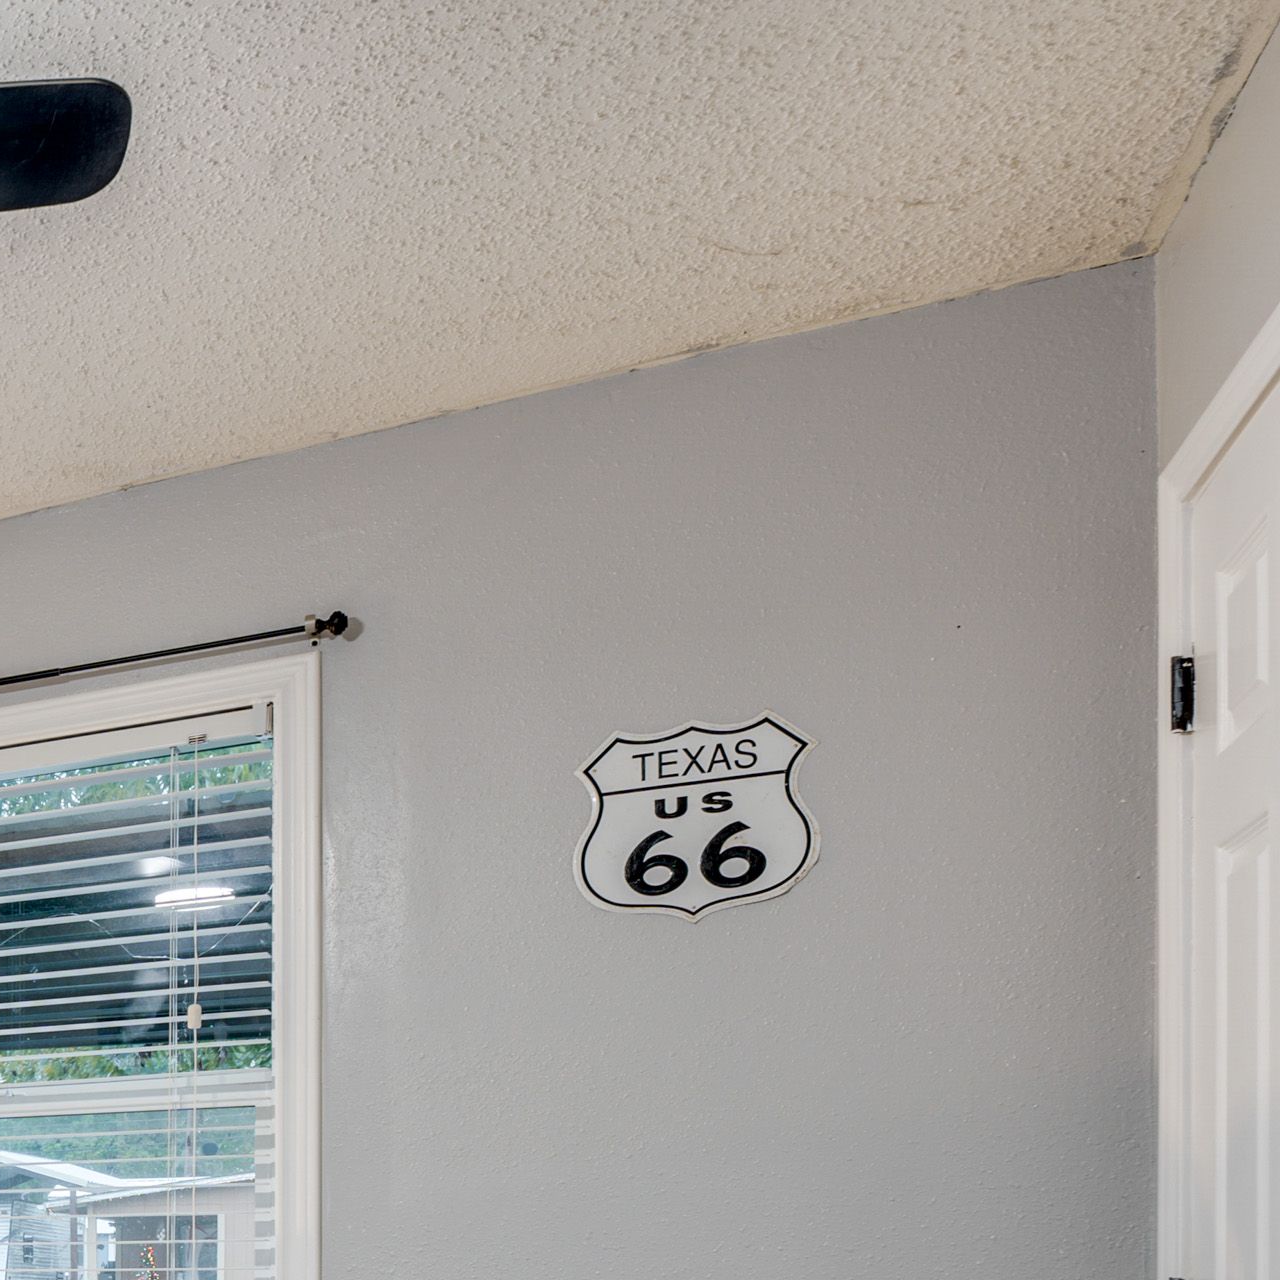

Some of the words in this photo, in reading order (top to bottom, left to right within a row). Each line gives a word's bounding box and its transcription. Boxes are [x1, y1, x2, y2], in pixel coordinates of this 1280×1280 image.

[632, 739, 758, 781] TEXAS
[654, 791, 733, 819] US
[624, 821, 767, 896] 66
